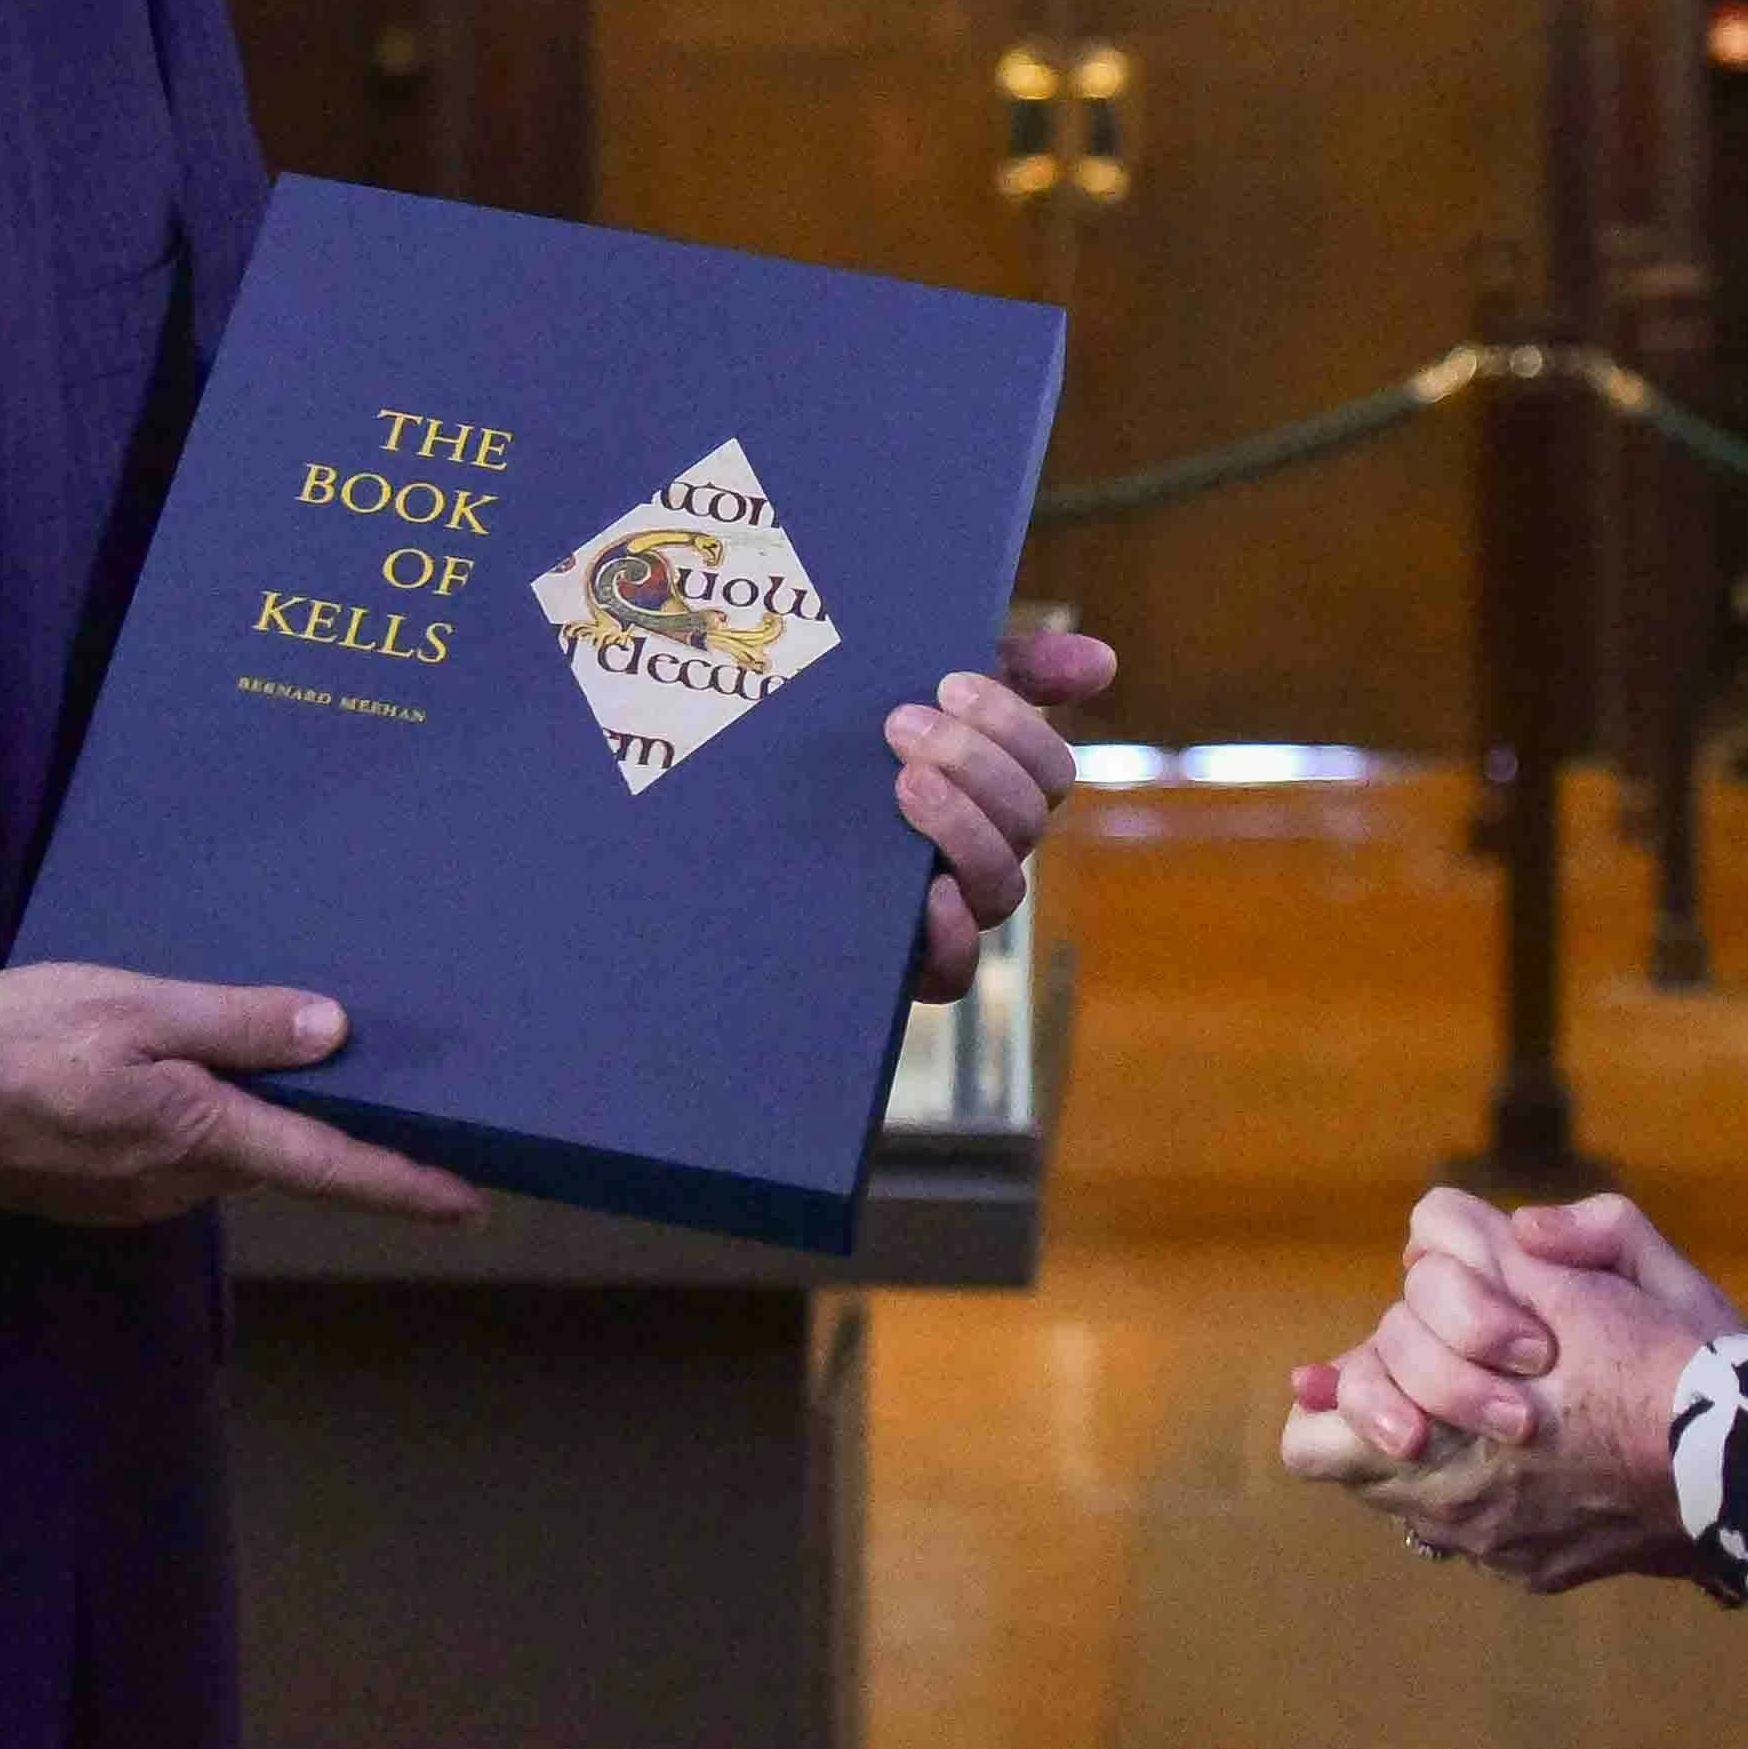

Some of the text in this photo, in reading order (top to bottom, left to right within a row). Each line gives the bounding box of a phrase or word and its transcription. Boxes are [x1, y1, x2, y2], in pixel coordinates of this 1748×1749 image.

[377, 408, 514, 471] THE
[294, 461, 499, 535] BOOK
[382, 548, 475, 596] OF
[251, 590, 457, 664] KELLS
[237, 676, 427, 723] BERNARD MEEHAN
